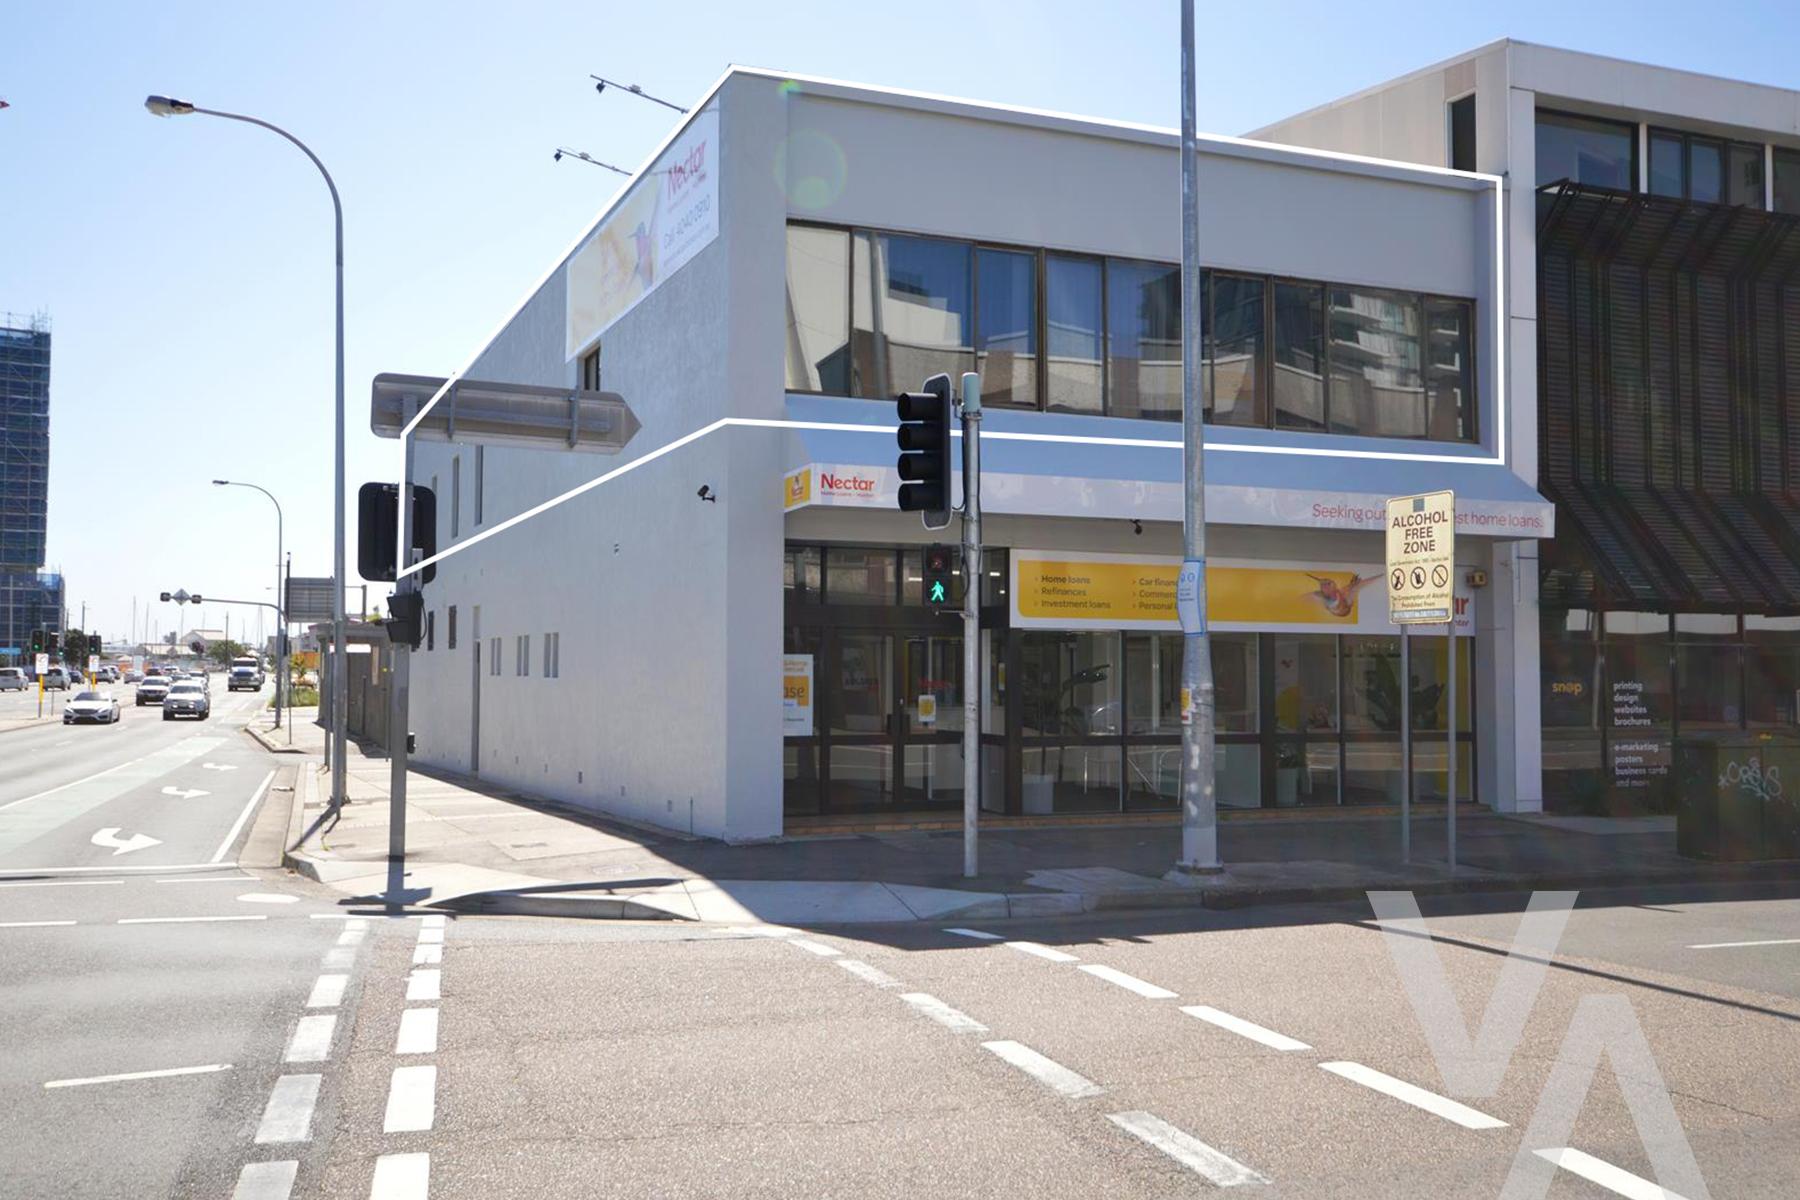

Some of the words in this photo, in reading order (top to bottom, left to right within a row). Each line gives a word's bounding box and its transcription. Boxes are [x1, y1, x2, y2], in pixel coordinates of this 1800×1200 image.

[820, 473, 875, 491] Nectar
[1312, 503, 1363, 523] Seeking
[1471, 511, 1506, 527] home
[1391, 510, 1449, 529] ALCOHOL
[1405, 526, 1433, 541] FREE
[1403, 540, 1436, 555] ZONE
[1041, 574, 1067, 584] Home
[1068, 575, 1091, 585] loans
[1139, 577, 1153, 586] Car
[1041, 586, 1087, 597] Refinances
[1041, 599, 1088, 609] Investment
[1088, 601, 1112, 610] loans
[1139, 601, 1173, 611] Personal
[1552, 682, 1582, 696] snap
[1613, 681, 1643, 692] printing
[1613, 693, 1640, 704] design
[1613, 705, 1648, 714] websites
[1614, 716, 1651, 726] brochures
[1614, 742, 1659, 753] e-marketing
[1615, 755, 1643, 765] posters
[1615, 766, 1646, 775] business
